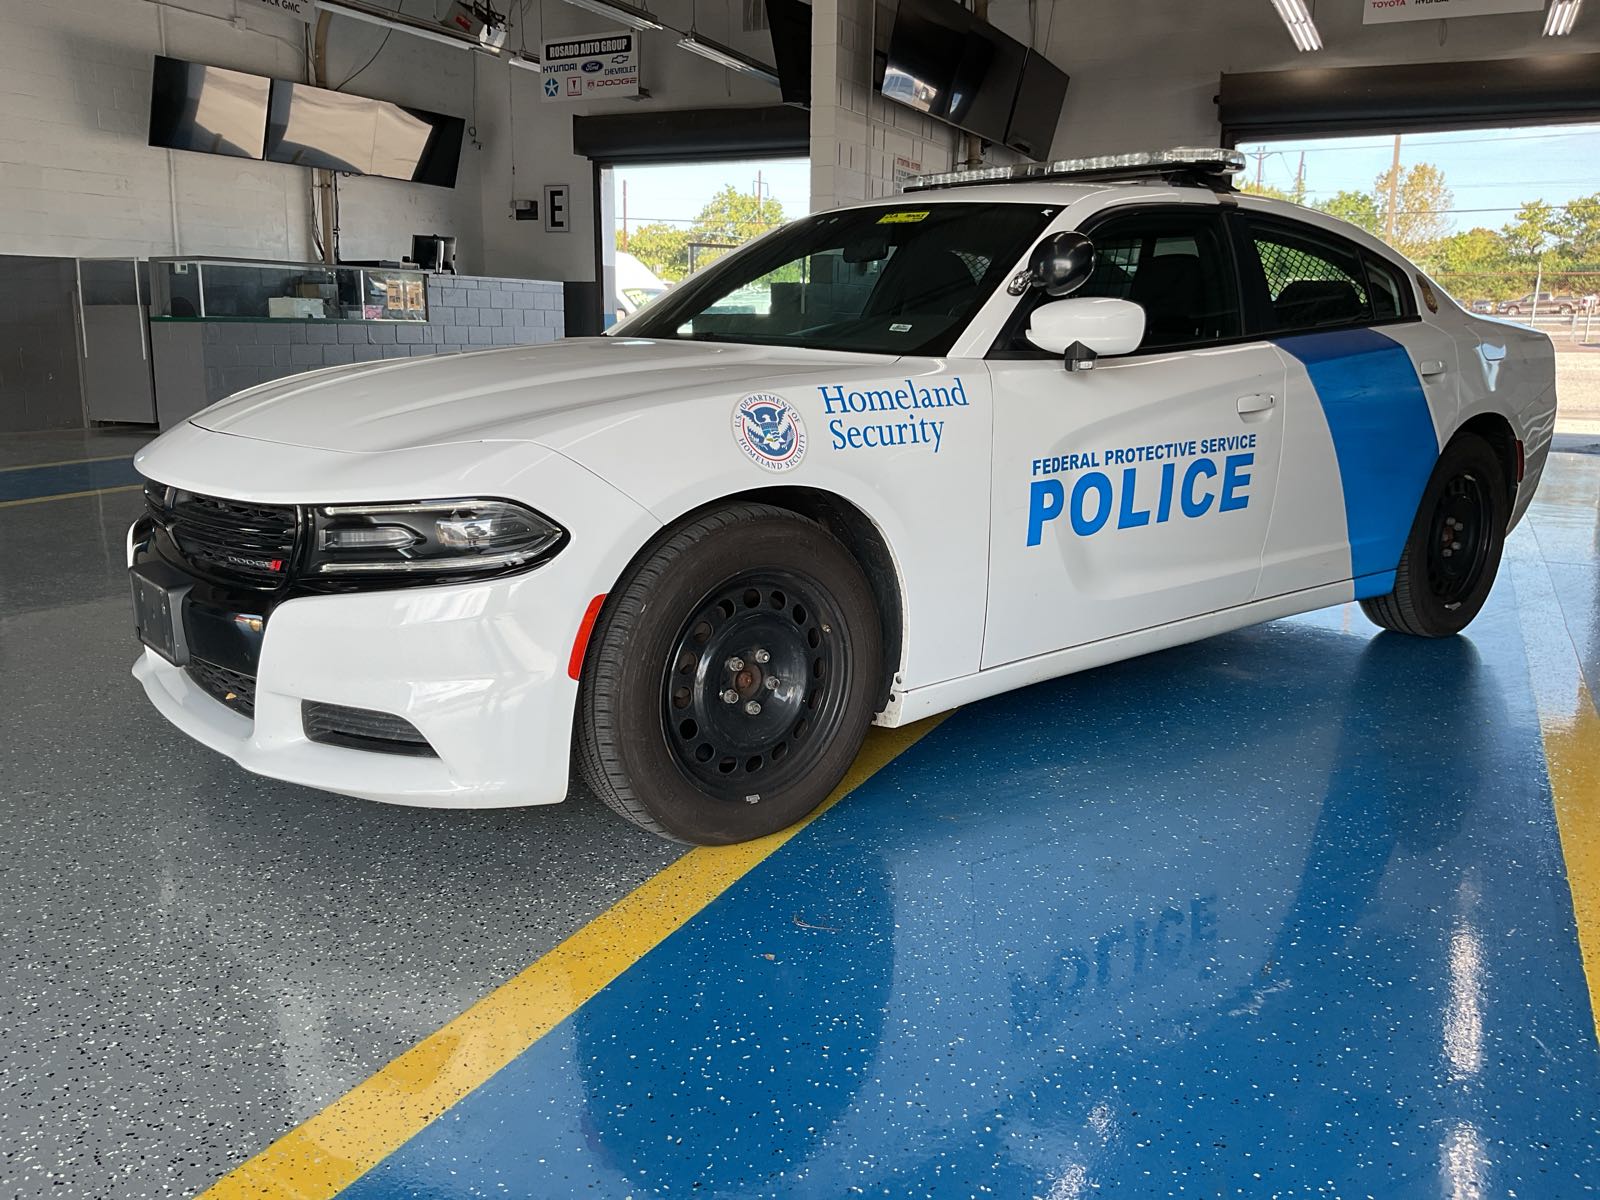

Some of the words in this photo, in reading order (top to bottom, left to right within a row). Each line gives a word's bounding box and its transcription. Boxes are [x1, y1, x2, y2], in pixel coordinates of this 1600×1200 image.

[281, 0, 300, 13] GMC
[1372, 0, 1406, 8] TOYOTA
[549, 43, 580, 58] ROSADO
[580, 41, 600, 55] AUTO
[601, 39, 627, 52] GROUP
[543, 63, 577, 73] HYUNDAI
[604, 66, 636, 75] CHEVROLET
[597, 78, 637, 87] DODGE
[550, 190, 564, 227] E
[817, 377, 970, 414] Homeland
[740, 394, 793, 413] DEPARTMENT
[791, 412, 801, 423] OF
[829, 414, 945, 453] Security
[738, 437, 783, 470] HOMELAND
[784, 433, 806, 469] SECURITY
[1032, 452, 1100, 476] FEDERAL
[1104, 440, 1197, 466] PROTECTIVE
[1200, 434, 1257, 454] SERVICE
[1026, 452, 1255, 547] POLICE
[228, 556, 272, 568] DODGE
